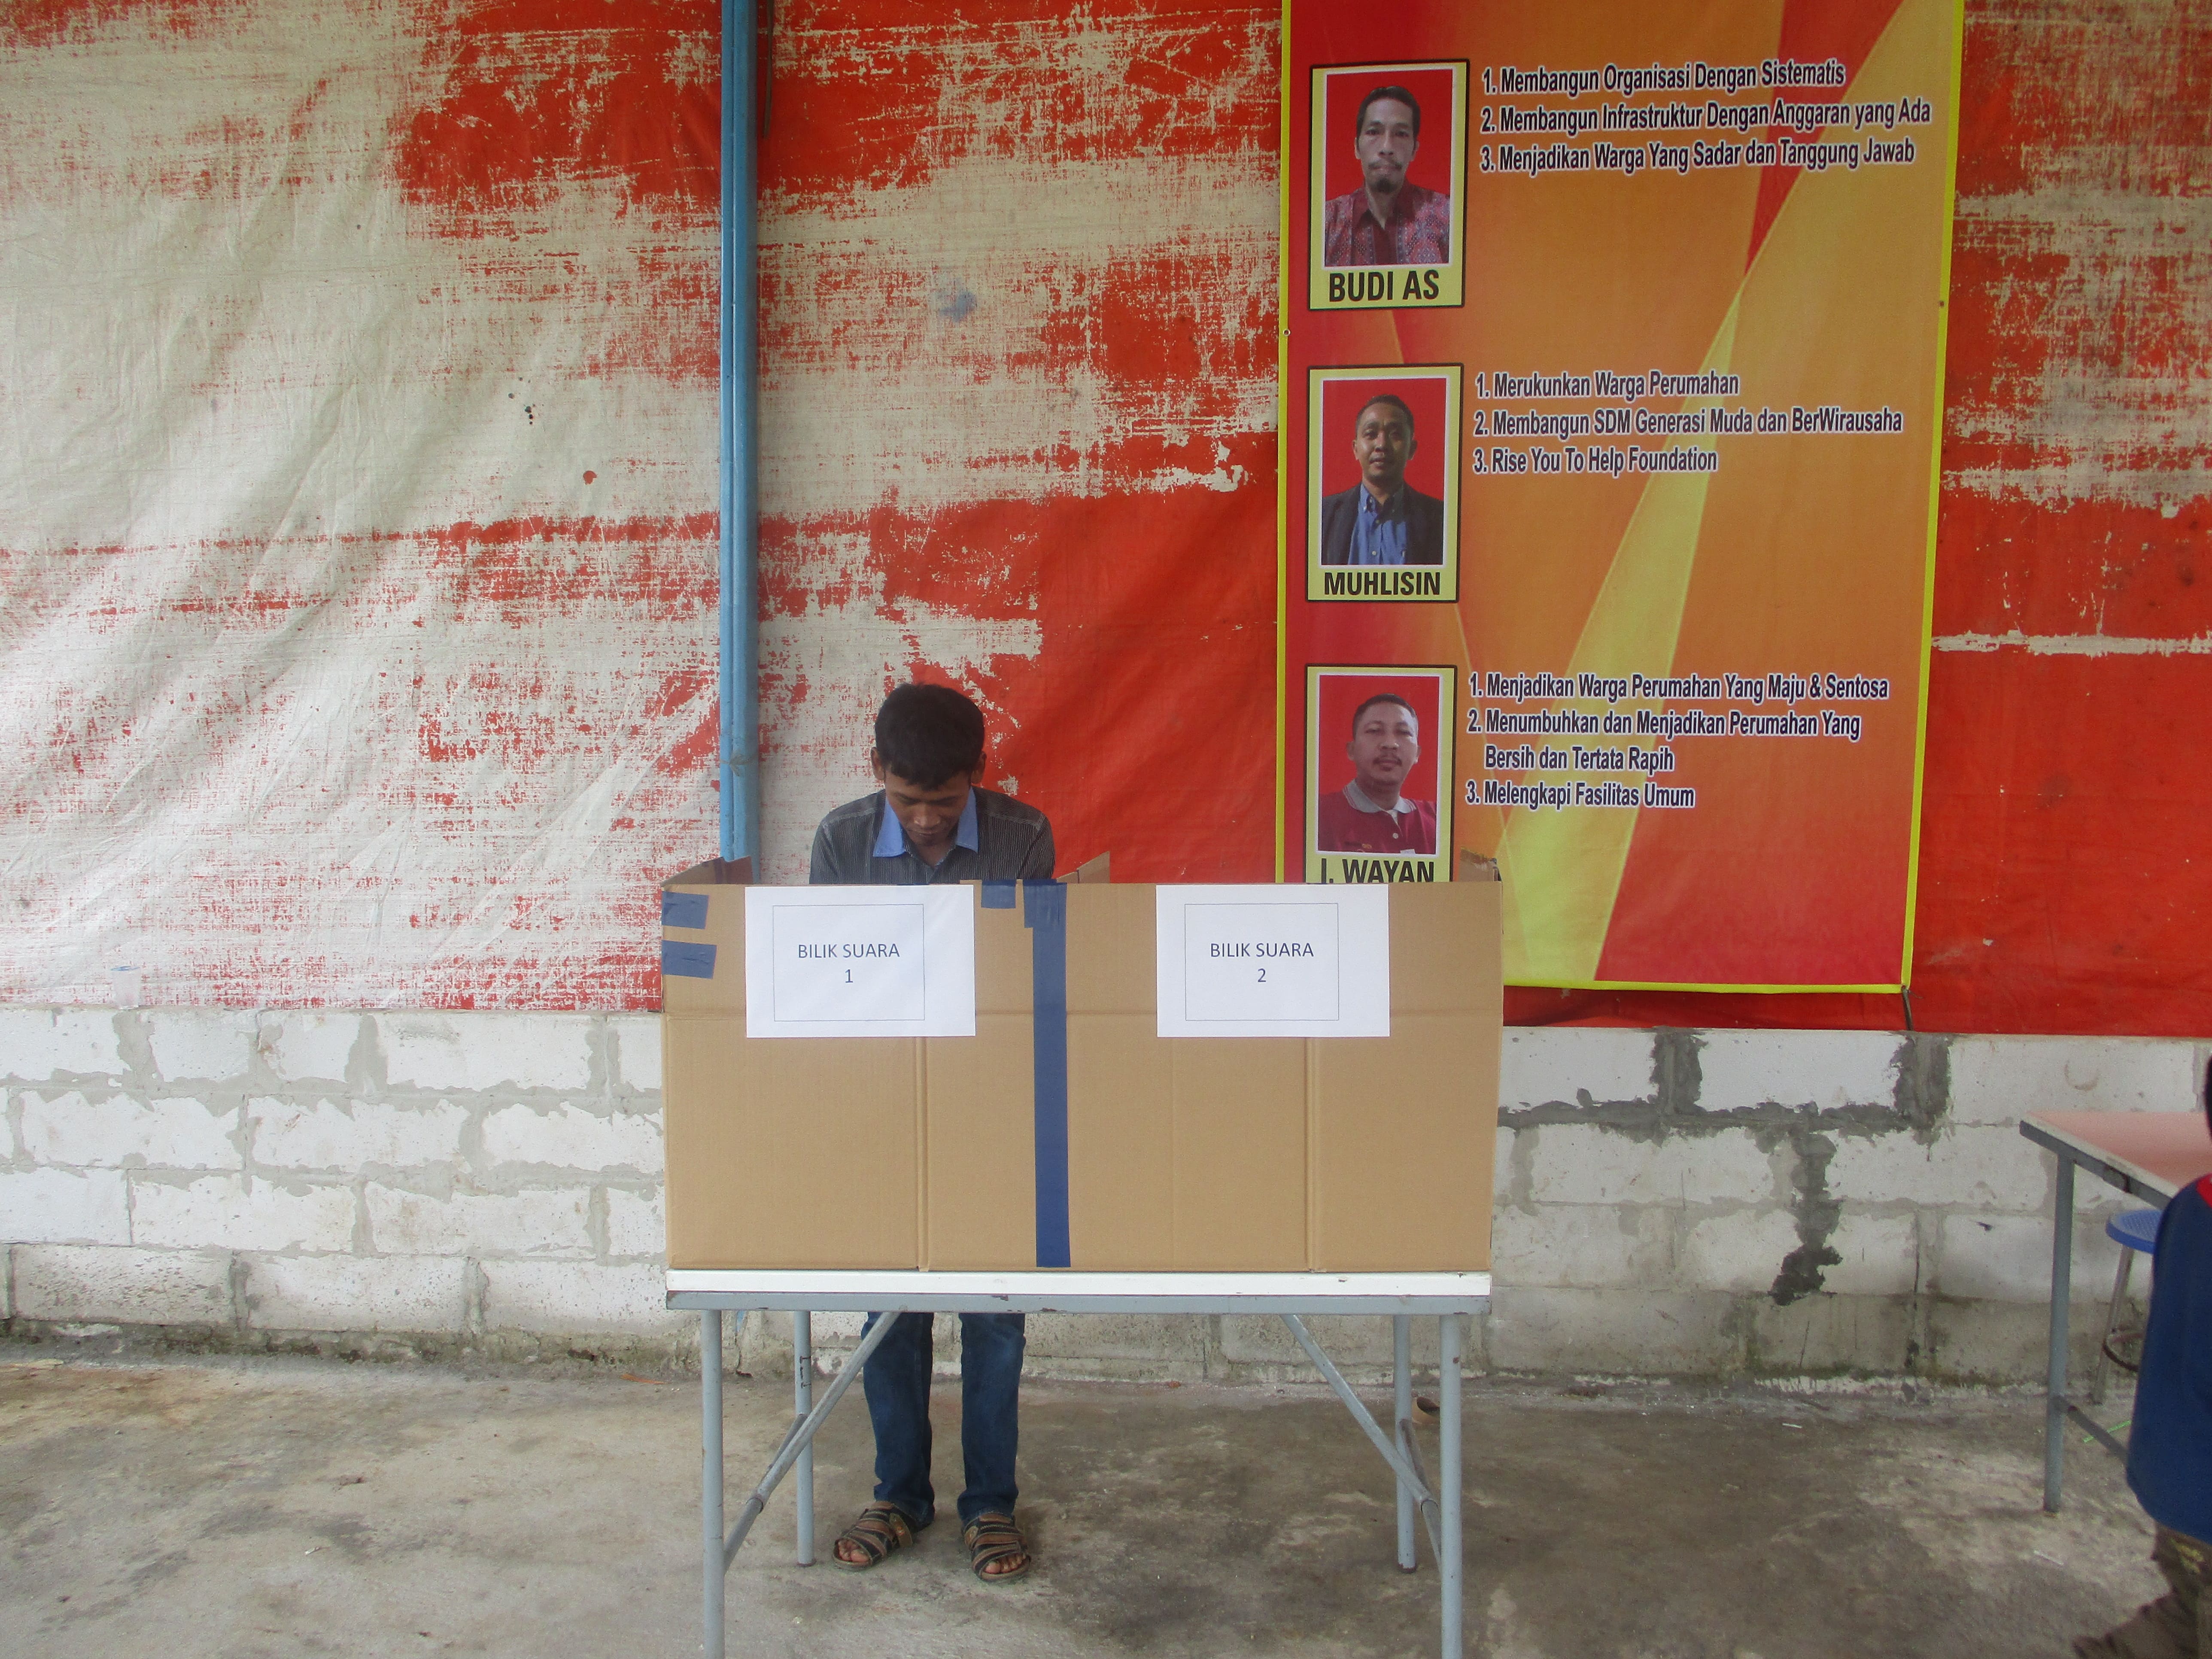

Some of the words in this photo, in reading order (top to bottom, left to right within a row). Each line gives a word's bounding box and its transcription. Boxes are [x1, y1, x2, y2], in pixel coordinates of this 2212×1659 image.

[1483, 69, 1496, 93] 1.
[1501, 67, 1599, 97] Membangun
[1604, 63, 1690, 96] Organisasi
[1695, 63, 1756, 94] Dengan
[1761, 59, 1844, 86] Sistematis
[1481, 107, 1495, 132] 2.
[1500, 106, 1598, 136] Membangun
[1603, 103, 1703, 129] Infrastruktur
[1707, 102, 1769, 132] Dengan
[1772, 99, 1850, 131] Anggaran
[1854, 103, 1895, 130] yang
[1898, 97, 1930, 123] Ada
[1481, 146, 1495, 171] 3.
[1499, 144, 1589, 176] Menjadikan
[1594, 143, 1644, 174] Warga
[1649, 142, 1689, 173] Yang
[1693, 141, 1741, 166] Sadar
[1745, 139, 1775, 164] dan
[1780, 139, 1859, 170] Tanggung
[1863, 137, 1915, 163] Jawab
[1329, 271, 1394, 302] BUDI
[1402, 269, 1440, 300] AS
[1477, 373, 1489, 397] 1.
[1494, 372, 1590, 397] Merukunkan
[1595, 371, 1645, 402] Warga
[1650, 370, 1739, 395] Perumahan
[1474, 411, 1488, 435] 2.
[1493, 410, 1589, 440] Membangun
[1594, 409, 1631, 434] SDM
[1635, 408, 1705, 433] Generasi
[1710, 408, 1753, 433] Muda
[1757, 408, 1787, 432] dan
[1792, 407, 1902, 432] BerWirausaha
[1474, 448, 1487, 473] 3.
[1492, 448, 1527, 472] Rise
[1531, 448, 1560, 472] You
[1565, 447, 1584, 471] To
[1589, 447, 1624, 477] Help
[1629, 447, 1717, 471] Foundation
[1324, 571, 1441, 596] MUHLISIN
[1470, 673, 1482, 696] 1.
[1487, 673, 1574, 703] Menjadikan
[1578, 674, 1627, 703] Warga
[1632, 674, 1720, 698] Perumahan
[1725, 674, 1763, 704] Yang
[1768, 674, 1805, 704] Maju
[1809, 674, 1821, 698] &
[1825, 674, 1888, 698] Sentosa
[1468, 709, 1481, 732] 2.
[1486, 709, 1598, 733] Menumbuhkan
[1603, 710, 1632, 734] dan
[1637, 710, 1725, 740] Menjadikan
[1729, 711, 1817, 735] Perumahan
[1822, 711, 1860, 741] Yang
[1485, 745, 1534, 769] Bersih
[1539, 746, 1567, 769] dan
[1572, 746, 1624, 770] Tertata
[1629, 747, 1674, 776] Rapih
[1466, 780, 1480, 803] 3.
[1484, 781, 1571, 810] Melengkapi
[1575, 782, 1639, 806] Fasilitas
[1644, 783, 1694, 807] Umum
[1342, 858, 1434, 883] WAYAN
[798, 944, 837, 959] BILIK
[843, 943, 900, 958] SUARA
[1210, 942, 1251, 957] BILIK
[1256, 942, 1314, 957] SUARA
[845, 969, 854, 983] 1
[1257, 968, 1267, 983] 2
